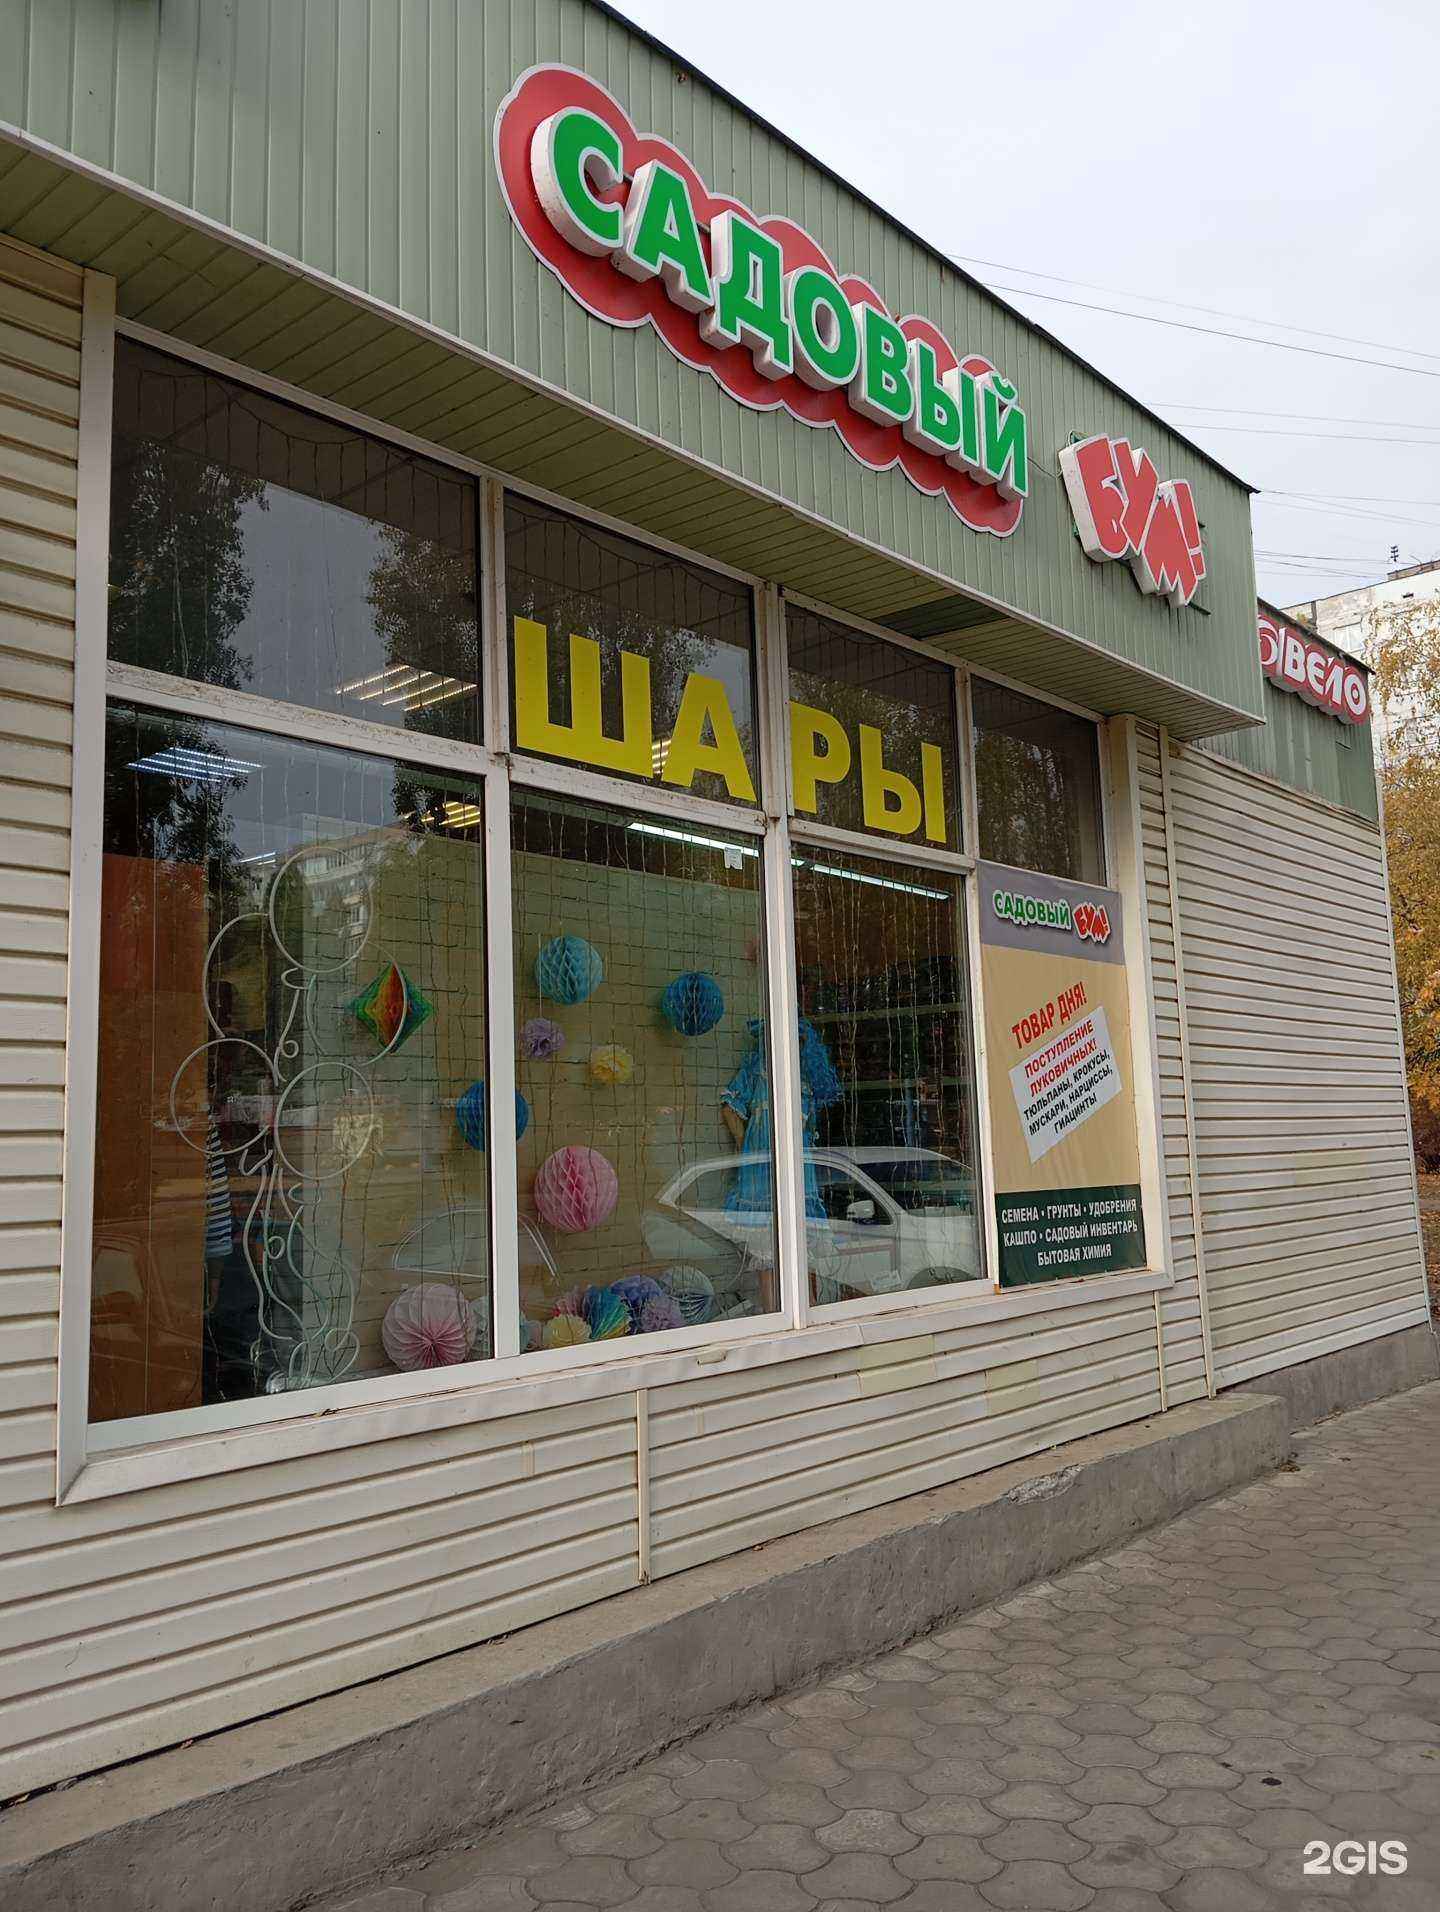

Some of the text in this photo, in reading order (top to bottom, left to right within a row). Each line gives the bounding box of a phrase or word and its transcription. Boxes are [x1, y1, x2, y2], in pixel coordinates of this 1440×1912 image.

[543, 105, 1206, 605] САДОВЫЙ БУМ!
[514, 615, 946, 843] ШАРЫ
[993, 892, 1111, 942] САДОВЫЙ БУМ!
[1012, 981, 1087, 1049] ТОВАР ДНЯ!
[1024, 1019, 1094, 1078] ПОСТУПЛЕНИЕ
[1030, 1038, 1097, 1097] ЛУКОВИЧНЫХ!
[1023, 1048, 1111, 1121] ТЮЛЬПАНЫ, КРОКУСЫ,
[1028, 1064, 1113, 1136] МУСКАРИ, НАРЦИССЫ,
[1053, 1092, 1097, 1134] ГИАЦИНТЫ
[1001, 1198, 1137, 1223] СЕМЕНА ГРУНТЫ УДОБРЕНИЯ
[1003, 1219, 1138, 1247] КАШПО САДОВЫЙ ИНВЕНТАРЬ
[1037, 1243, 1112, 1266] БЫТОВАЯ ХИМИЯ
